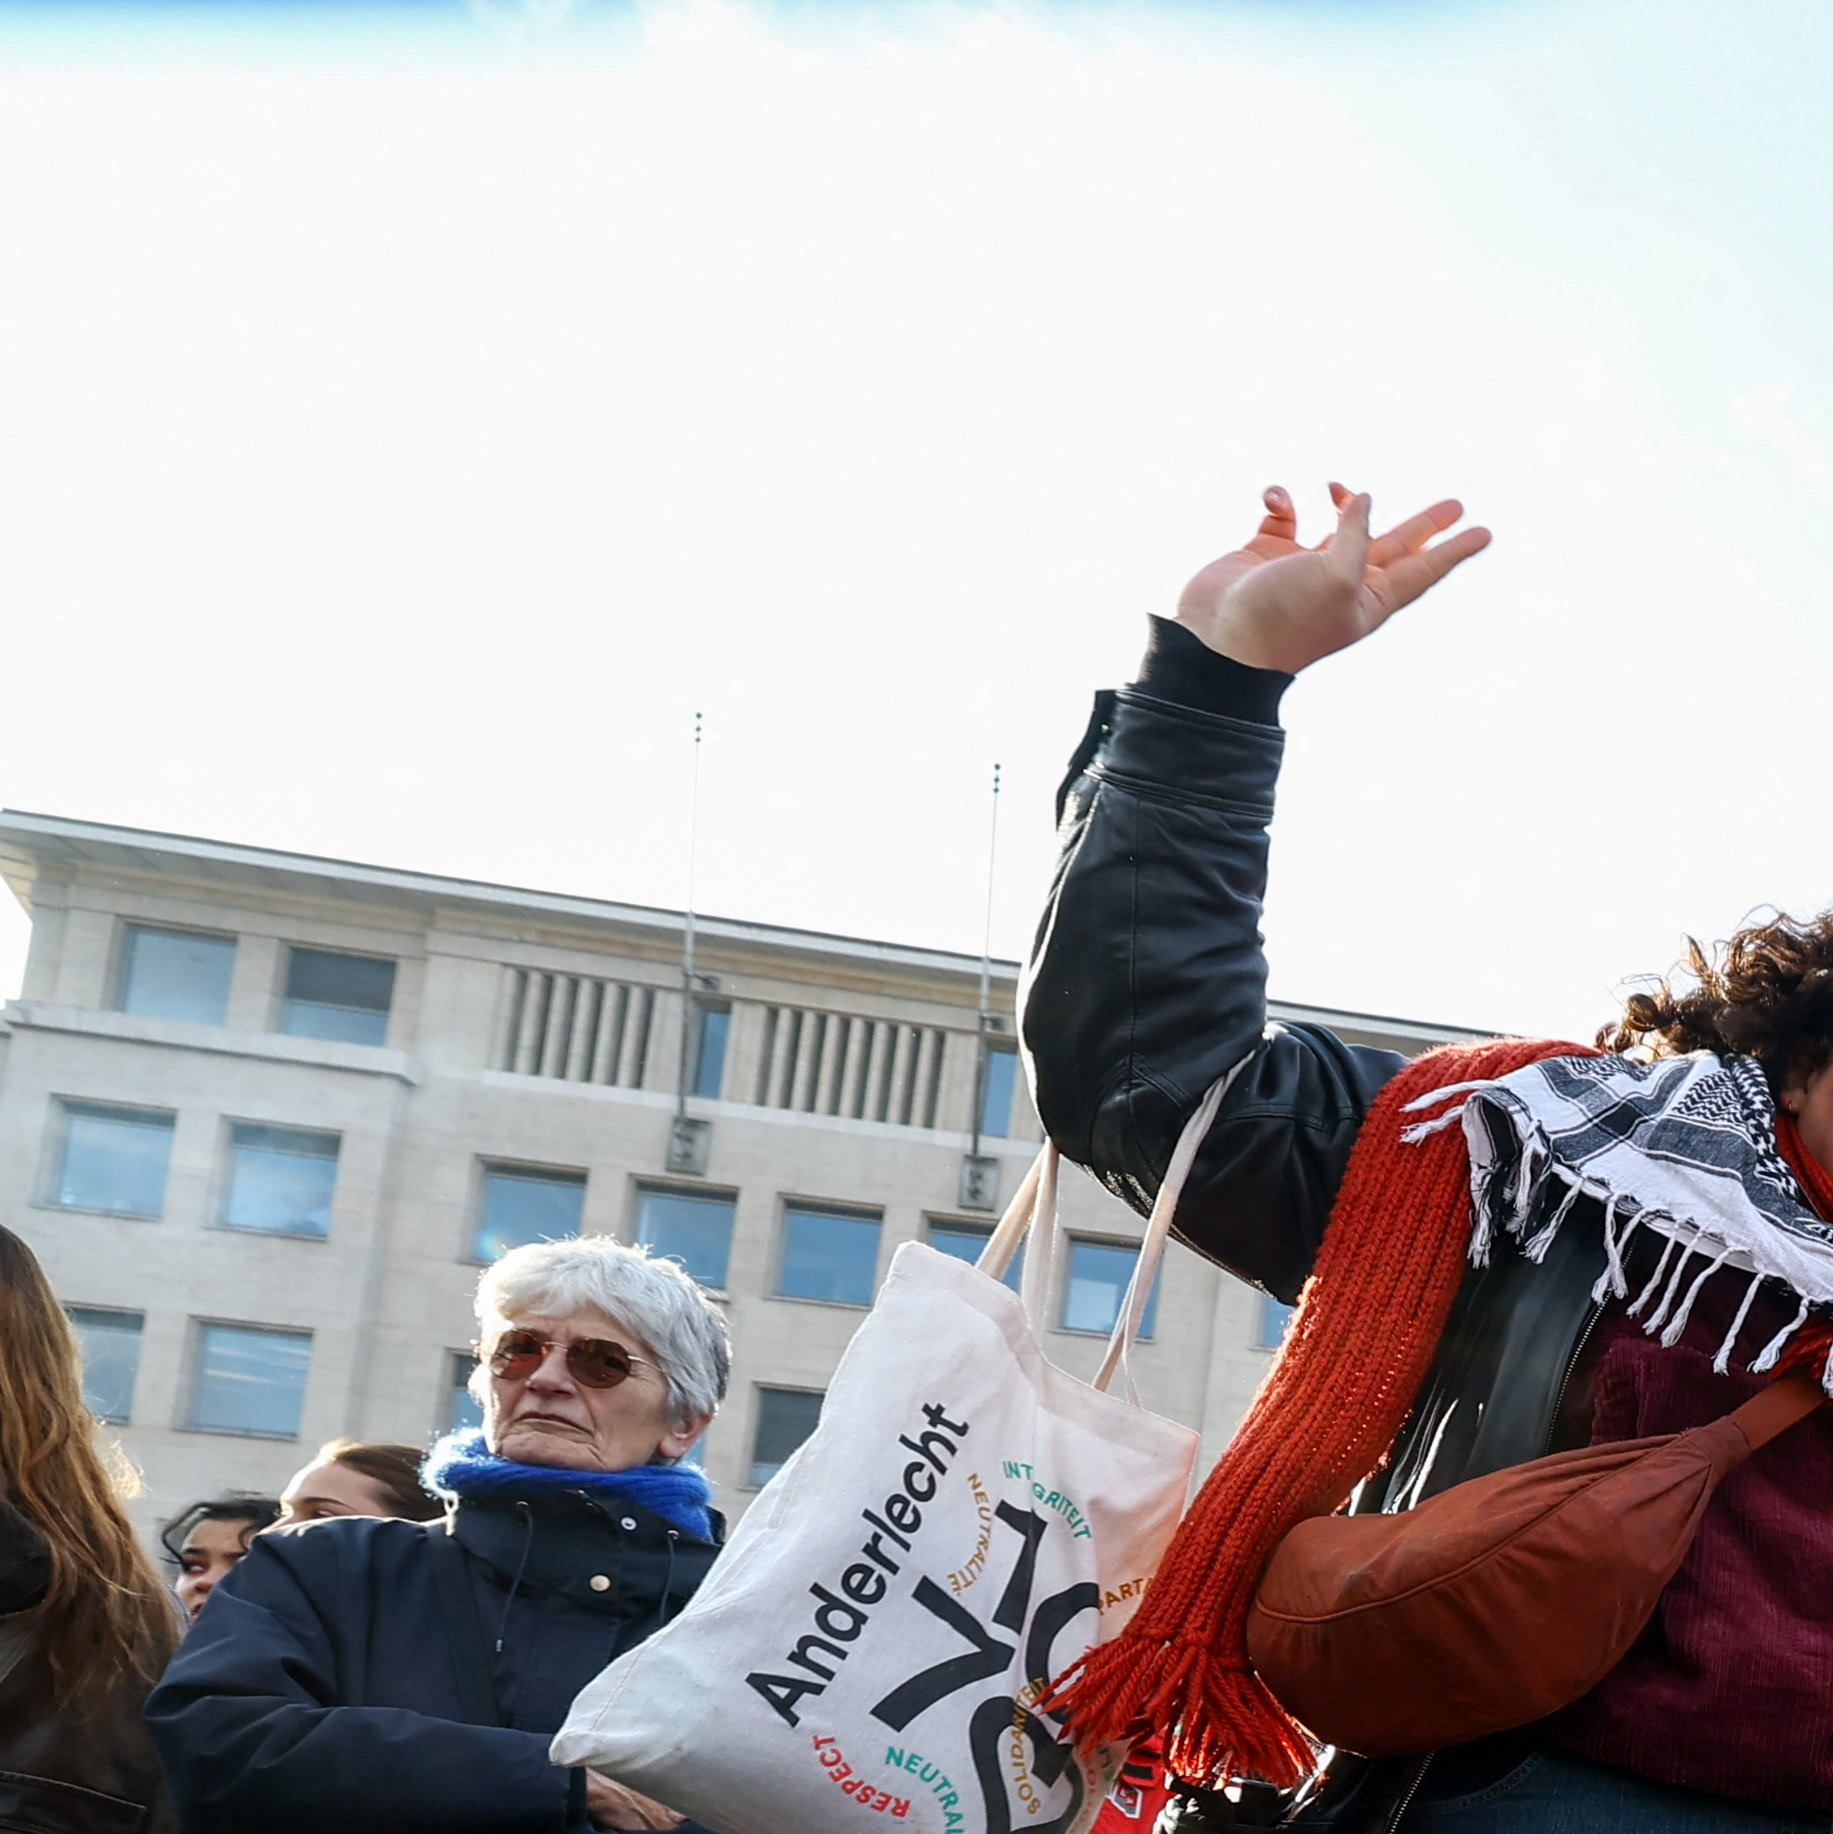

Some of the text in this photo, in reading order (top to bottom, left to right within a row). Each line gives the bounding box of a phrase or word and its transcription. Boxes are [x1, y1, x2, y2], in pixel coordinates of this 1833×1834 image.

[1002, 1460, 1092, 1539] INTGRITEIT
[744, 1402, 970, 1729] Anderlecht
[812, 1733, 912, 1818] RESPECT
